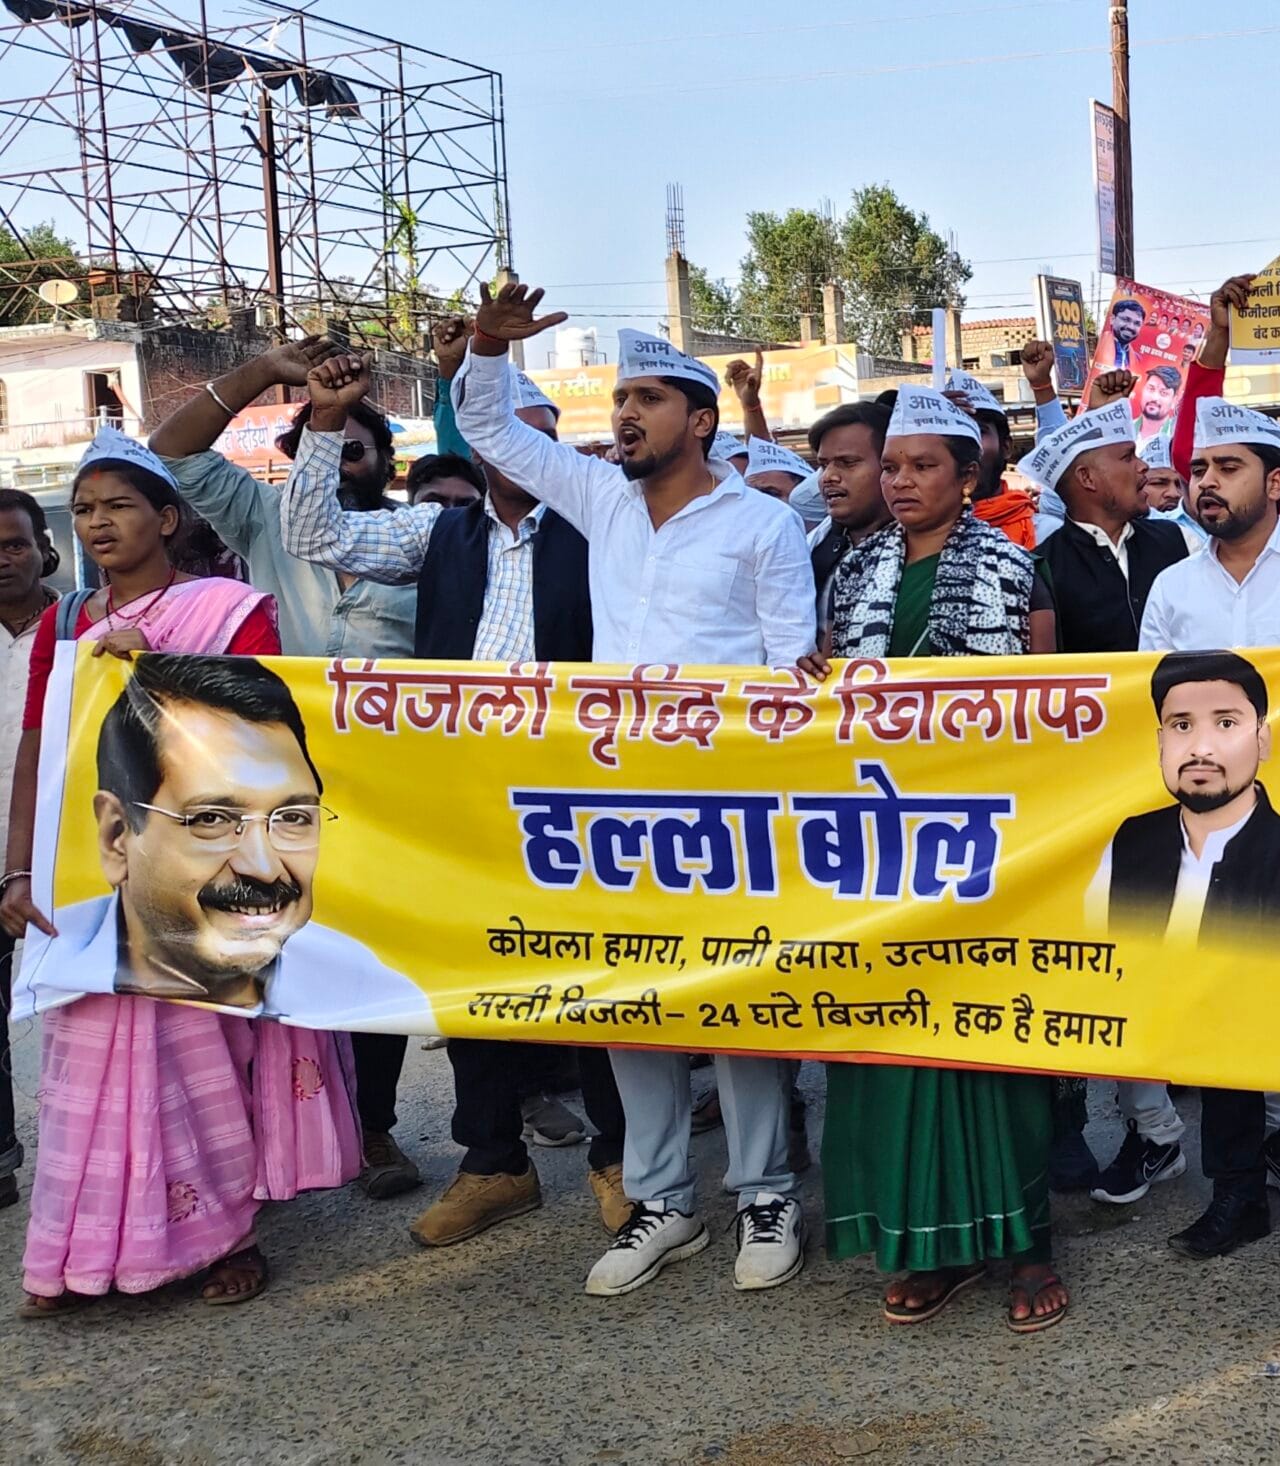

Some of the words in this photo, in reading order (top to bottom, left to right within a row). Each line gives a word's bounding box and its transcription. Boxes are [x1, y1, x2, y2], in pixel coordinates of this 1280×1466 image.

[1246, 281, 1274, 298] जली
[1052, 299, 1081, 323] TOO
[634, 340, 672, 355] आम
[1253, 325, 1269, 340] बंद
[1051, 417, 1094, 447] आदमी
[1097, 403, 1128, 423] पार्टी
[1211, 405, 1244, 418] आम
[328, 658, 553, 736] बिजली
[570, 663, 725, 767] वृद्धि
[742, 665, 817, 740] के
[833, 657, 1109, 741] खिलाफ
[511, 788, 781, 893] हल्ला
[791, 762, 1013, 900] बोल
[486, 916, 595, 961] कोयला
[602, 934, 688, 971] हमारा,
[702, 925, 773, 967] पानी
[775, 939, 873, 973] हमारा,
[882, 936, 1020, 968] उत्पादन
[1027, 938, 1124, 981] हमारा,
[467, 983, 552, 1024] सस्ती
[699, 1003, 741, 1029] 24
[748, 991, 803, 1029] घंटे
[811, 988, 940, 1037] बिजली,
[951, 1001, 1006, 1038] हक
[1011, 993, 1035, 1044] है
[1042, 1009, 1128, 1048] हमारा
